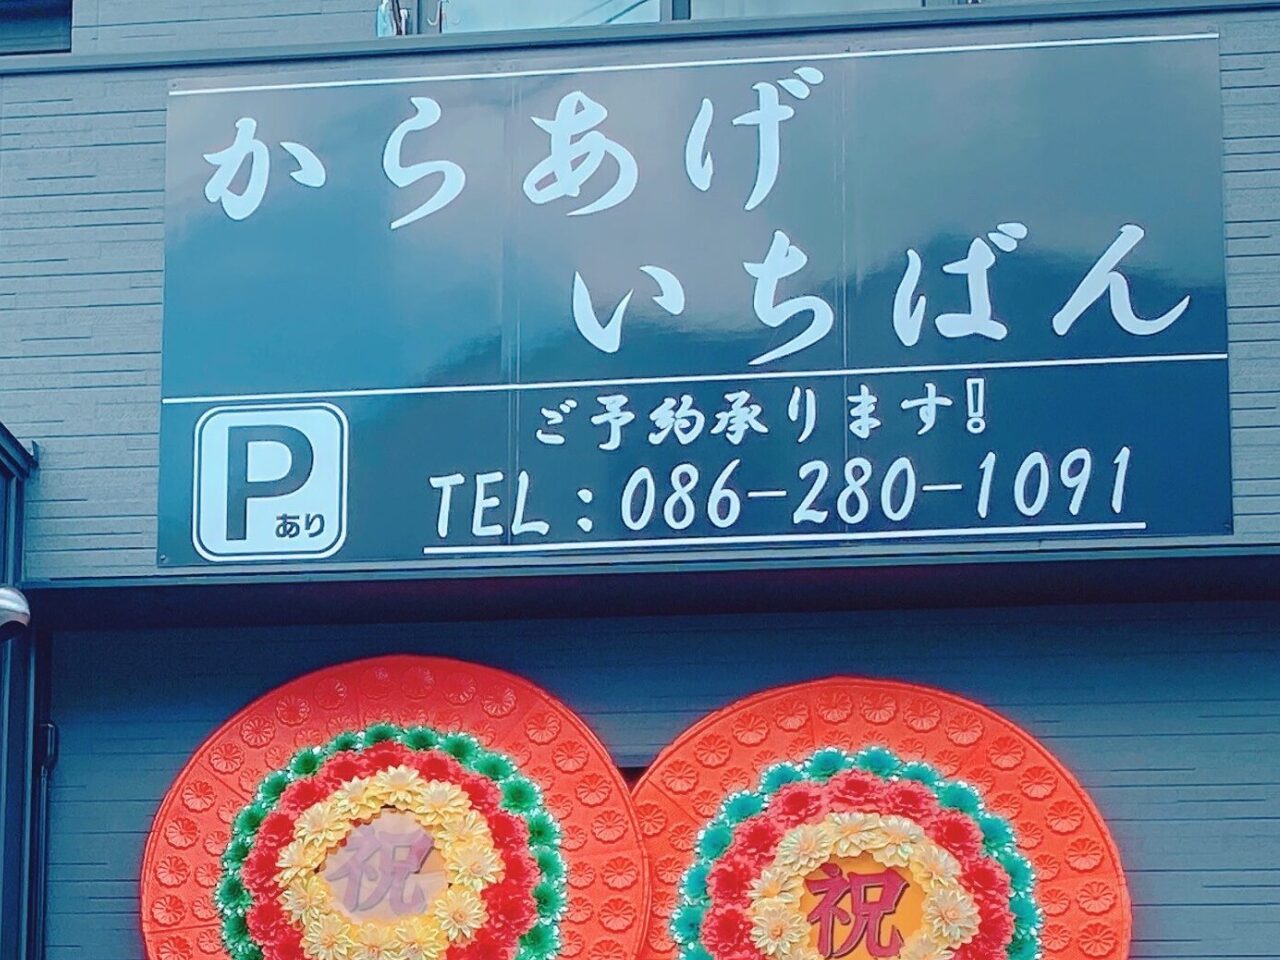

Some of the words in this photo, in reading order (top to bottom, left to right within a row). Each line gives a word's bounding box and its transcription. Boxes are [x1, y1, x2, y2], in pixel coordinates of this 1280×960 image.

[202, 66, 824, 229] からあげ
[571, 221, 1191, 366] いちばん
[534, 377, 986, 449] ご予約承ります!
[226, 424, 314, 541] P
[275, 513, 325, 539] あり
[325, 825, 435, 915] 祝
[803, 862, 910, 960] 祝
